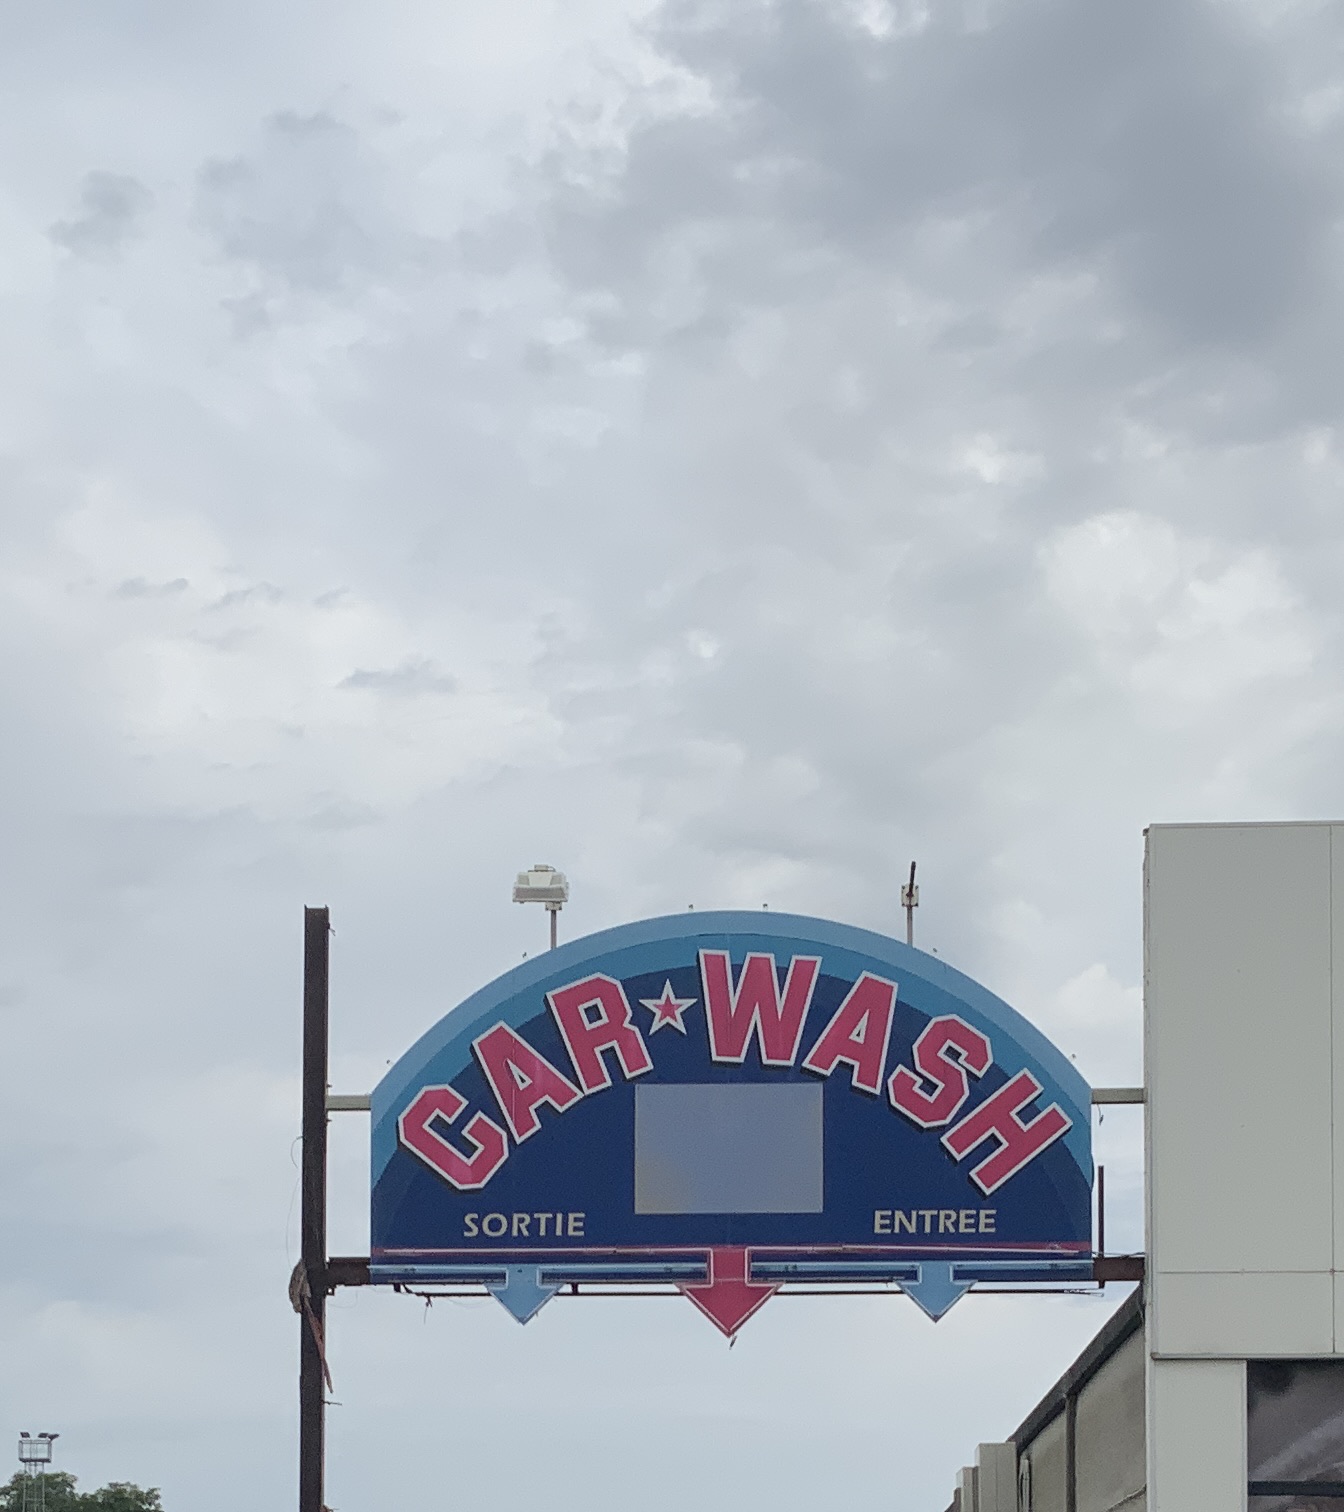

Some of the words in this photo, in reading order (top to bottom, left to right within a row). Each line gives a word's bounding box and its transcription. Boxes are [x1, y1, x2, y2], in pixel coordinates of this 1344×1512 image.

[398, 972, 655, 1193] CAR
[699, 949, 1073, 1197] WASH
[463, 1212, 586, 1237] SORTIE
[874, 1209, 997, 1234] ENTREE
